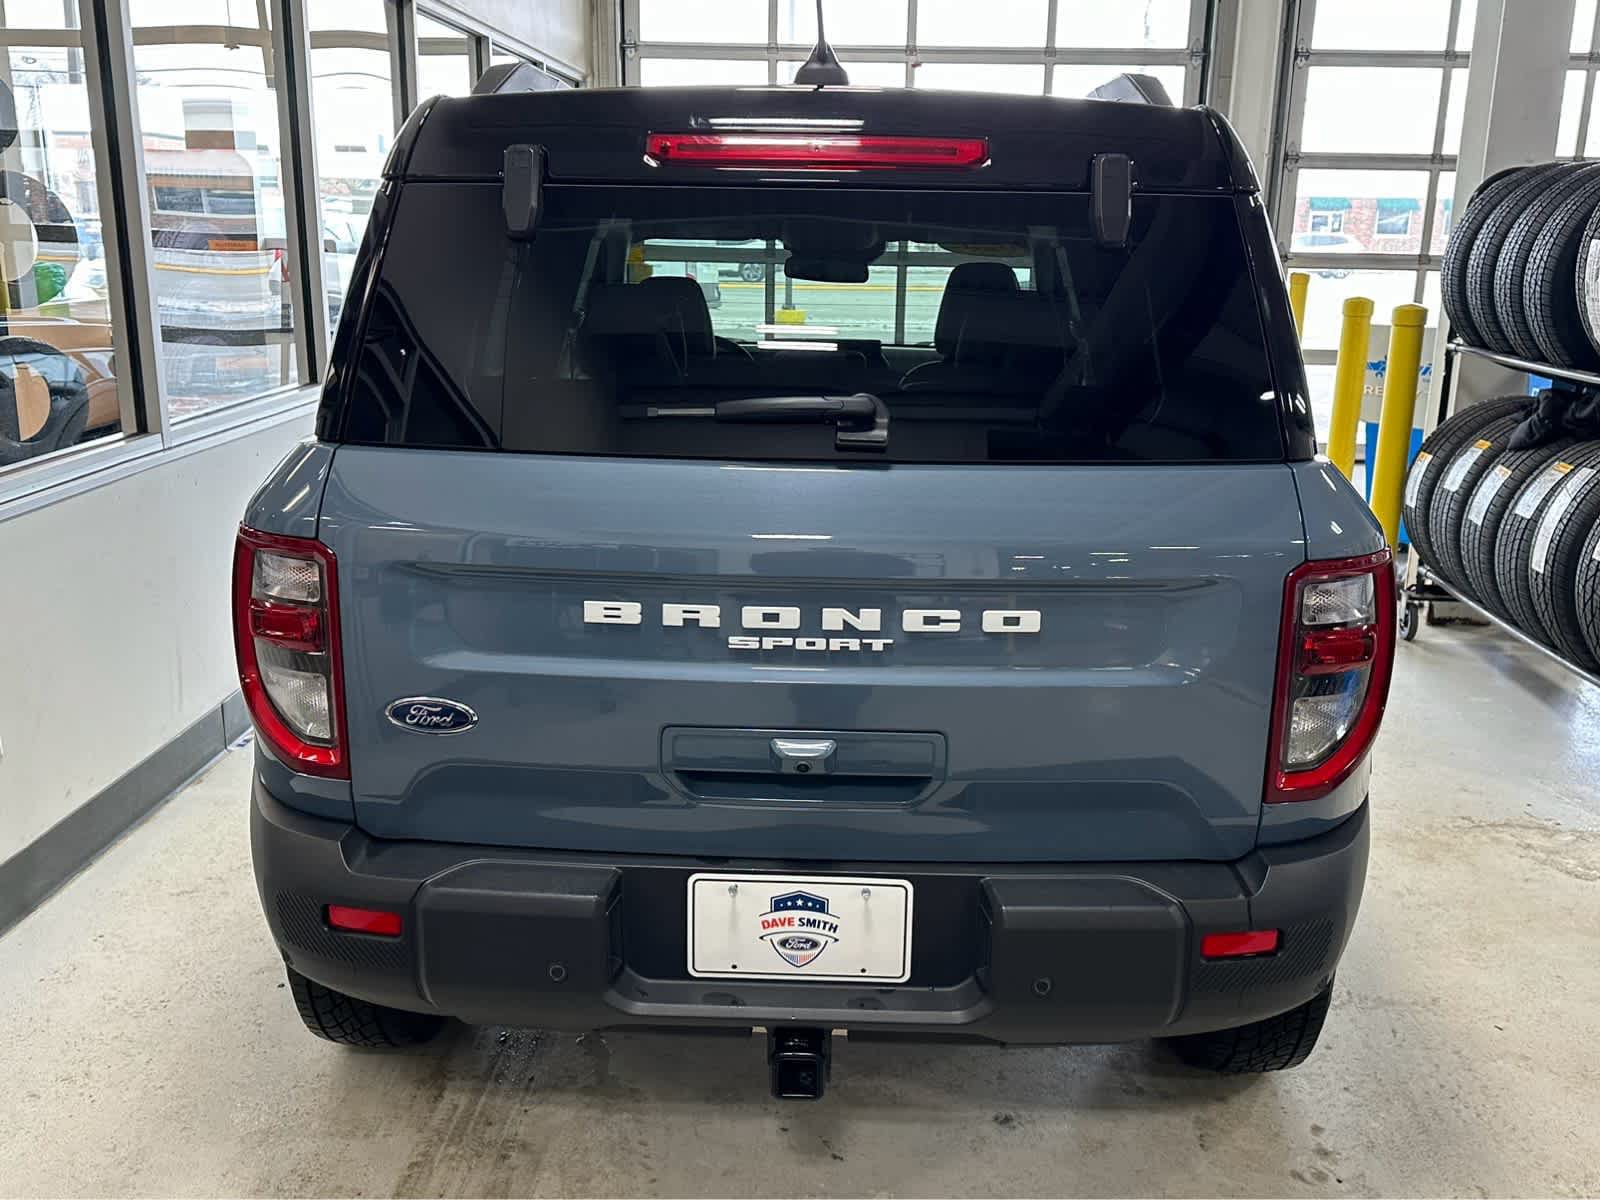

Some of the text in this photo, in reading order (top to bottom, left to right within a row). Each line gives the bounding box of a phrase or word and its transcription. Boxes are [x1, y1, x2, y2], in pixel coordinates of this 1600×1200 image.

[583, 600, 1042, 633] BRONCO
[727, 636, 894, 651] SPORT
[405, 704, 455, 727] Ford
[761, 916, 839, 933] DAVE SMITH
[785, 937, 813, 950] Ford
